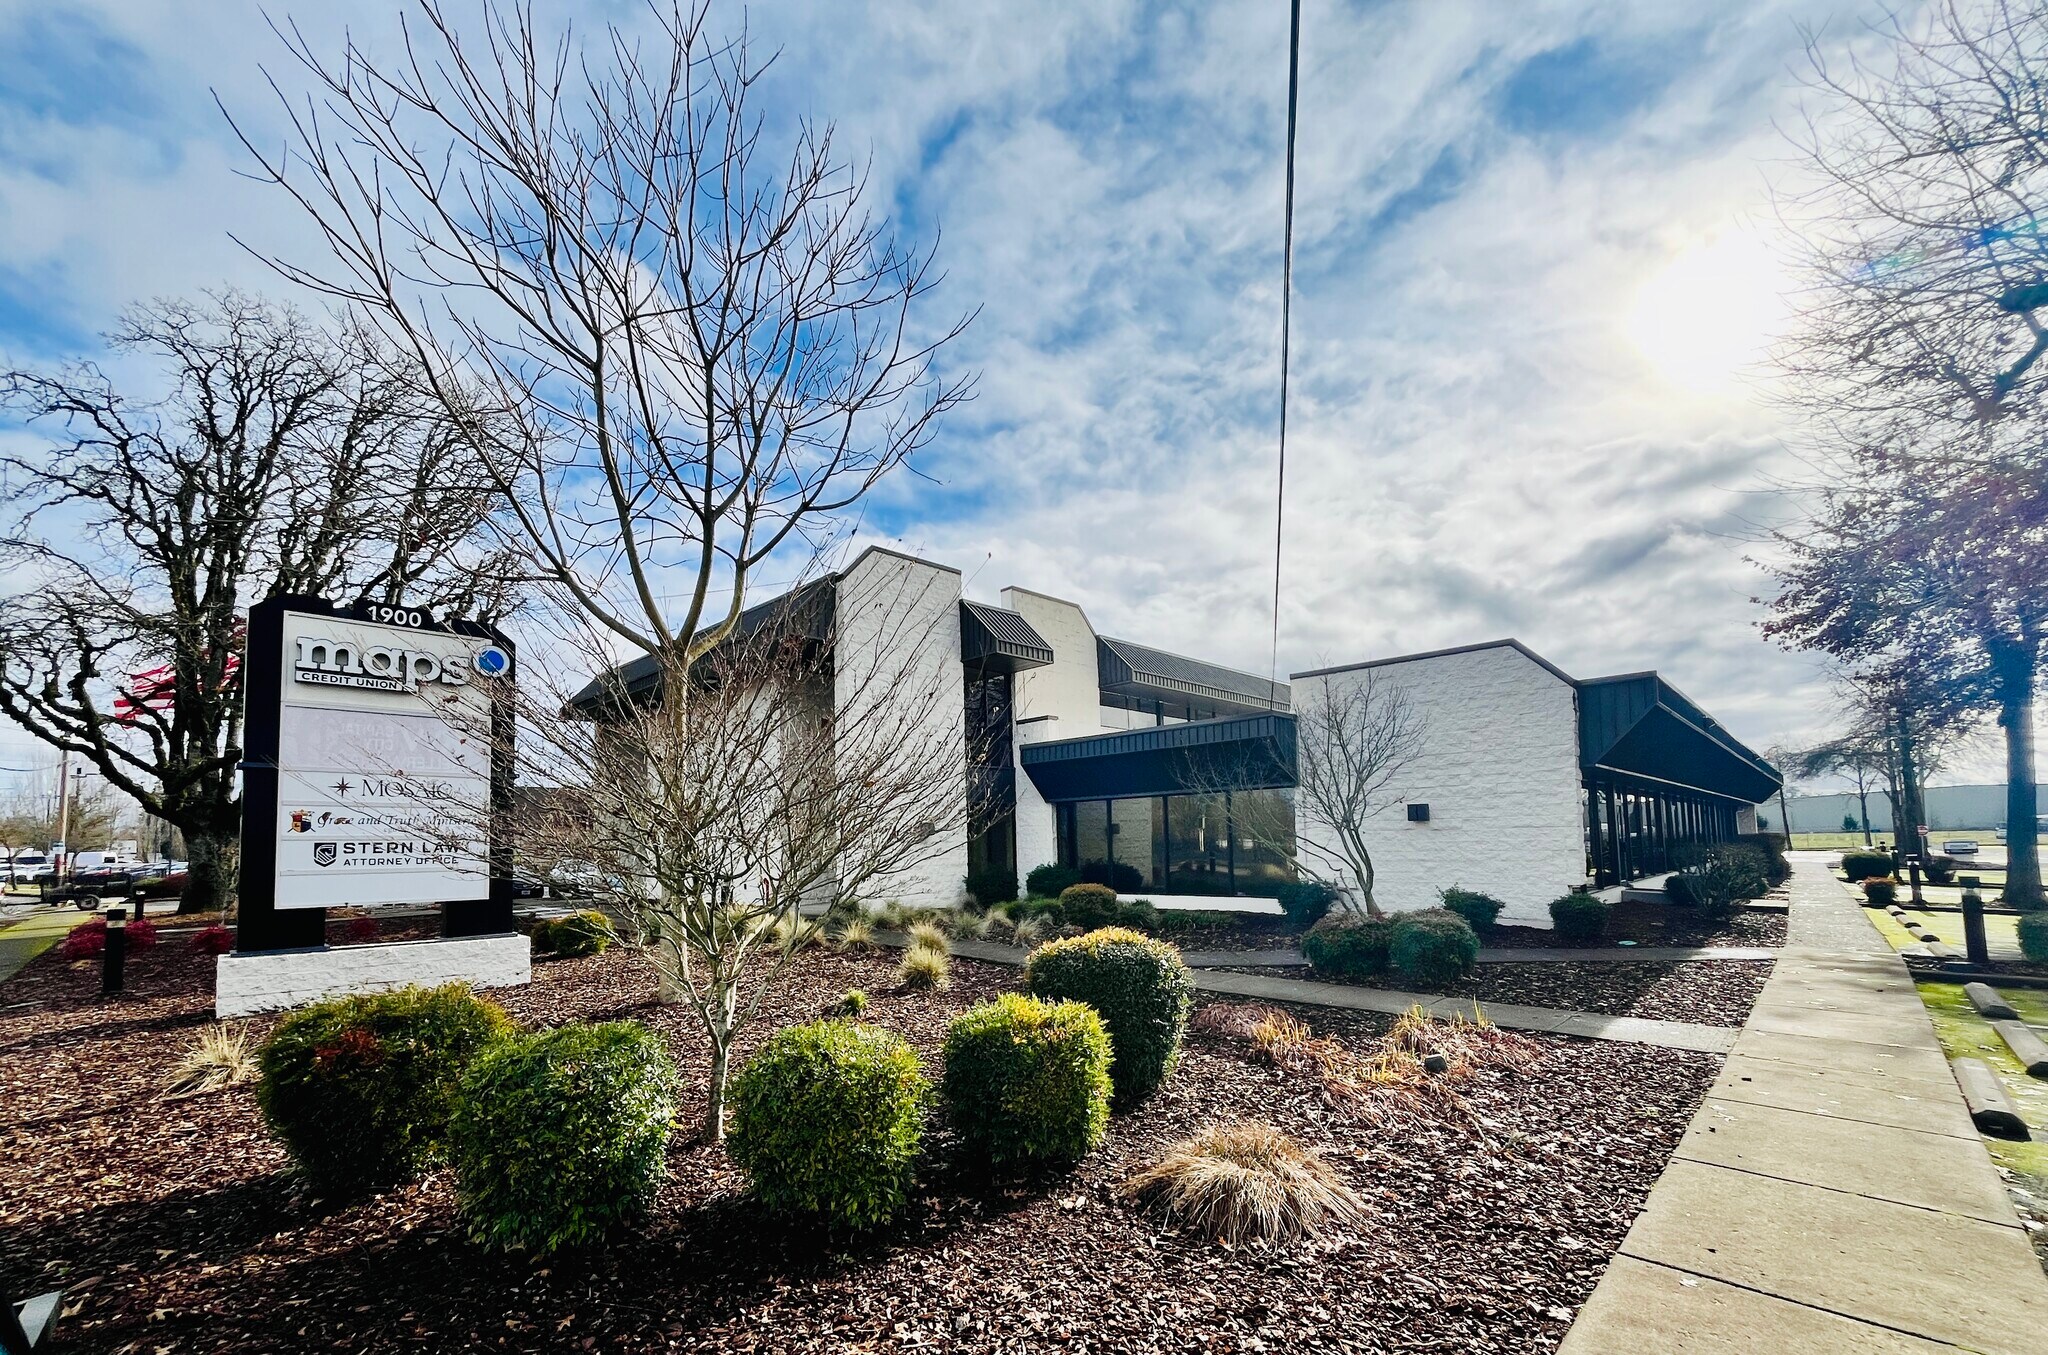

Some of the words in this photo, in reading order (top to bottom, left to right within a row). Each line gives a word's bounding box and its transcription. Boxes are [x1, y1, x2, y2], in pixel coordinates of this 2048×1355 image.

[368, 605, 422, 628] 1900
[296, 636, 470, 692] maps
[301, 673, 351, 685] CREDIT
[356, 678, 397, 690] UNION
[362, 779, 453, 797] MOSAIC
[317, 811, 354, 828] Grce
[358, 813, 382, 825] and
[343, 842, 413, 854] STERN
[422, 842, 460, 854] LAW
[343, 857, 411, 866] ATTORNEY
[416, 857, 458, 865] OFFICE
